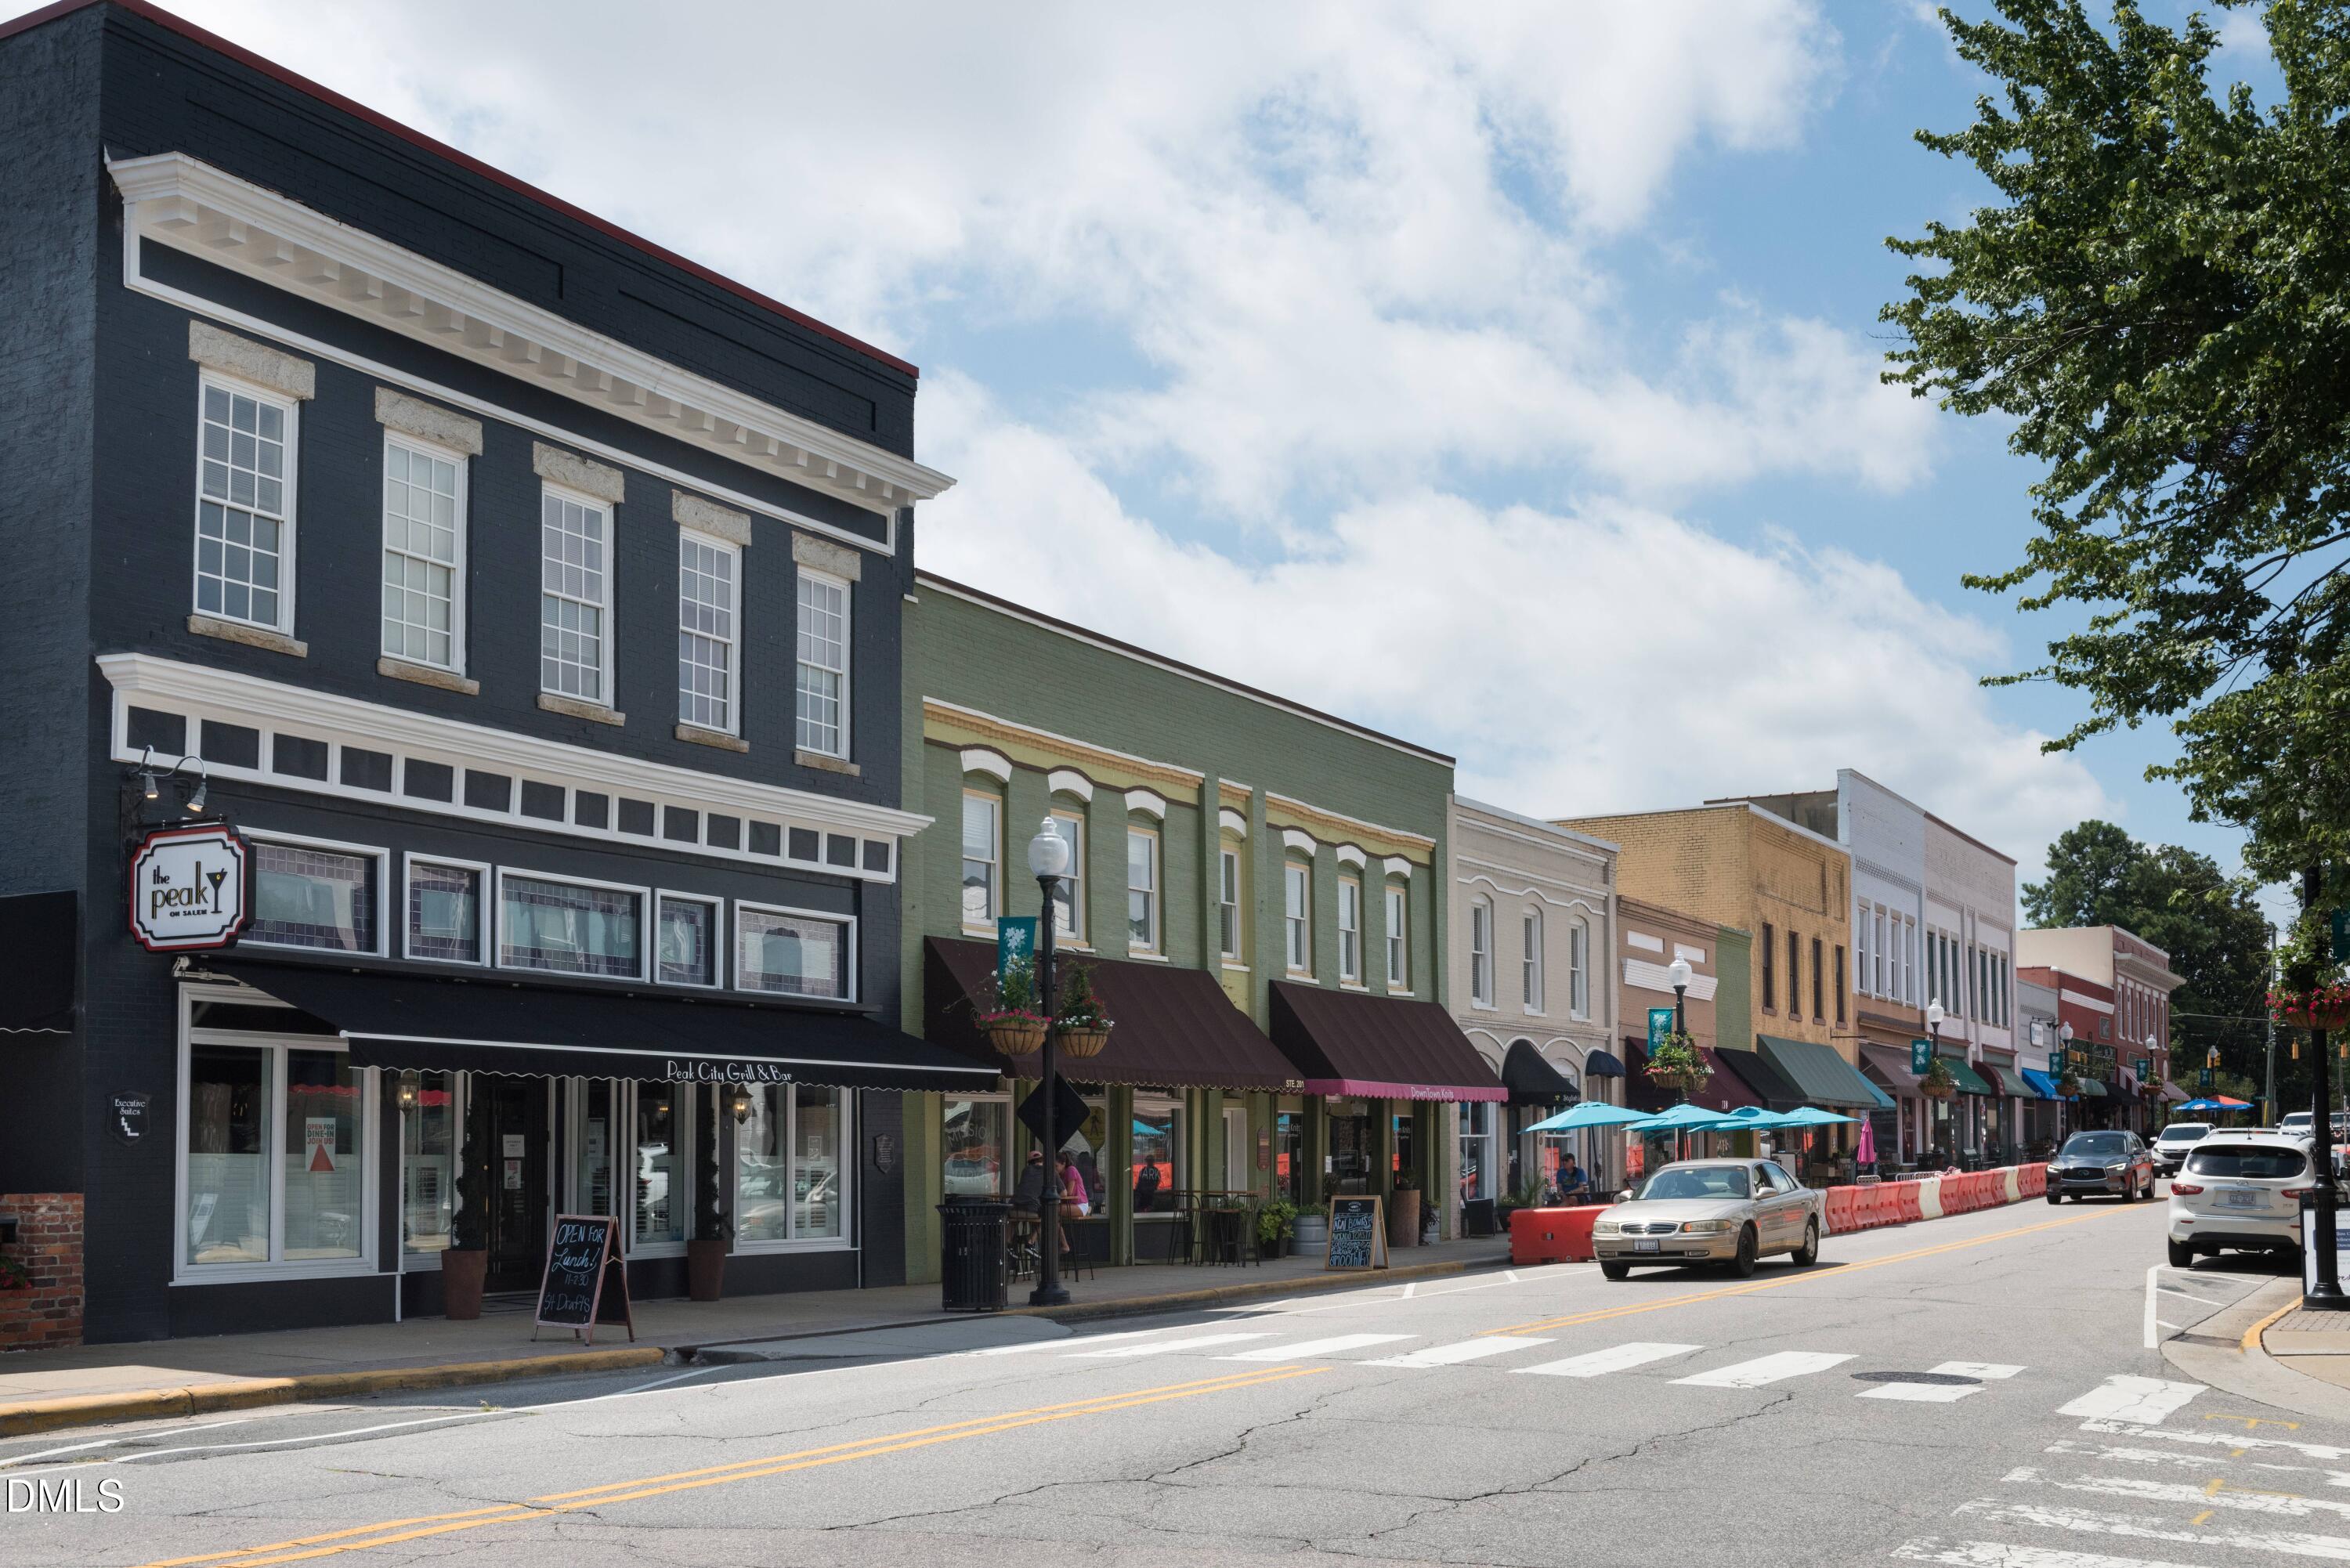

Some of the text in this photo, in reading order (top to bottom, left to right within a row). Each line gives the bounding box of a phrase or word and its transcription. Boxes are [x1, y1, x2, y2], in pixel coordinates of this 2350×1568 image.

[153, 865, 170, 884] the
[151, 861, 208, 919] peak
[667, 1060, 792, 1083] Peak City Grill & Bar
[114, 1098, 146, 1107] Executive
[1411, 1086, 1454, 1098] DownTown Knits
[556, 1223, 605, 1245] OPEN FOR
[551, 1247, 601, 1272] Lunch!
[556, 1293, 591, 1313] Drafts
